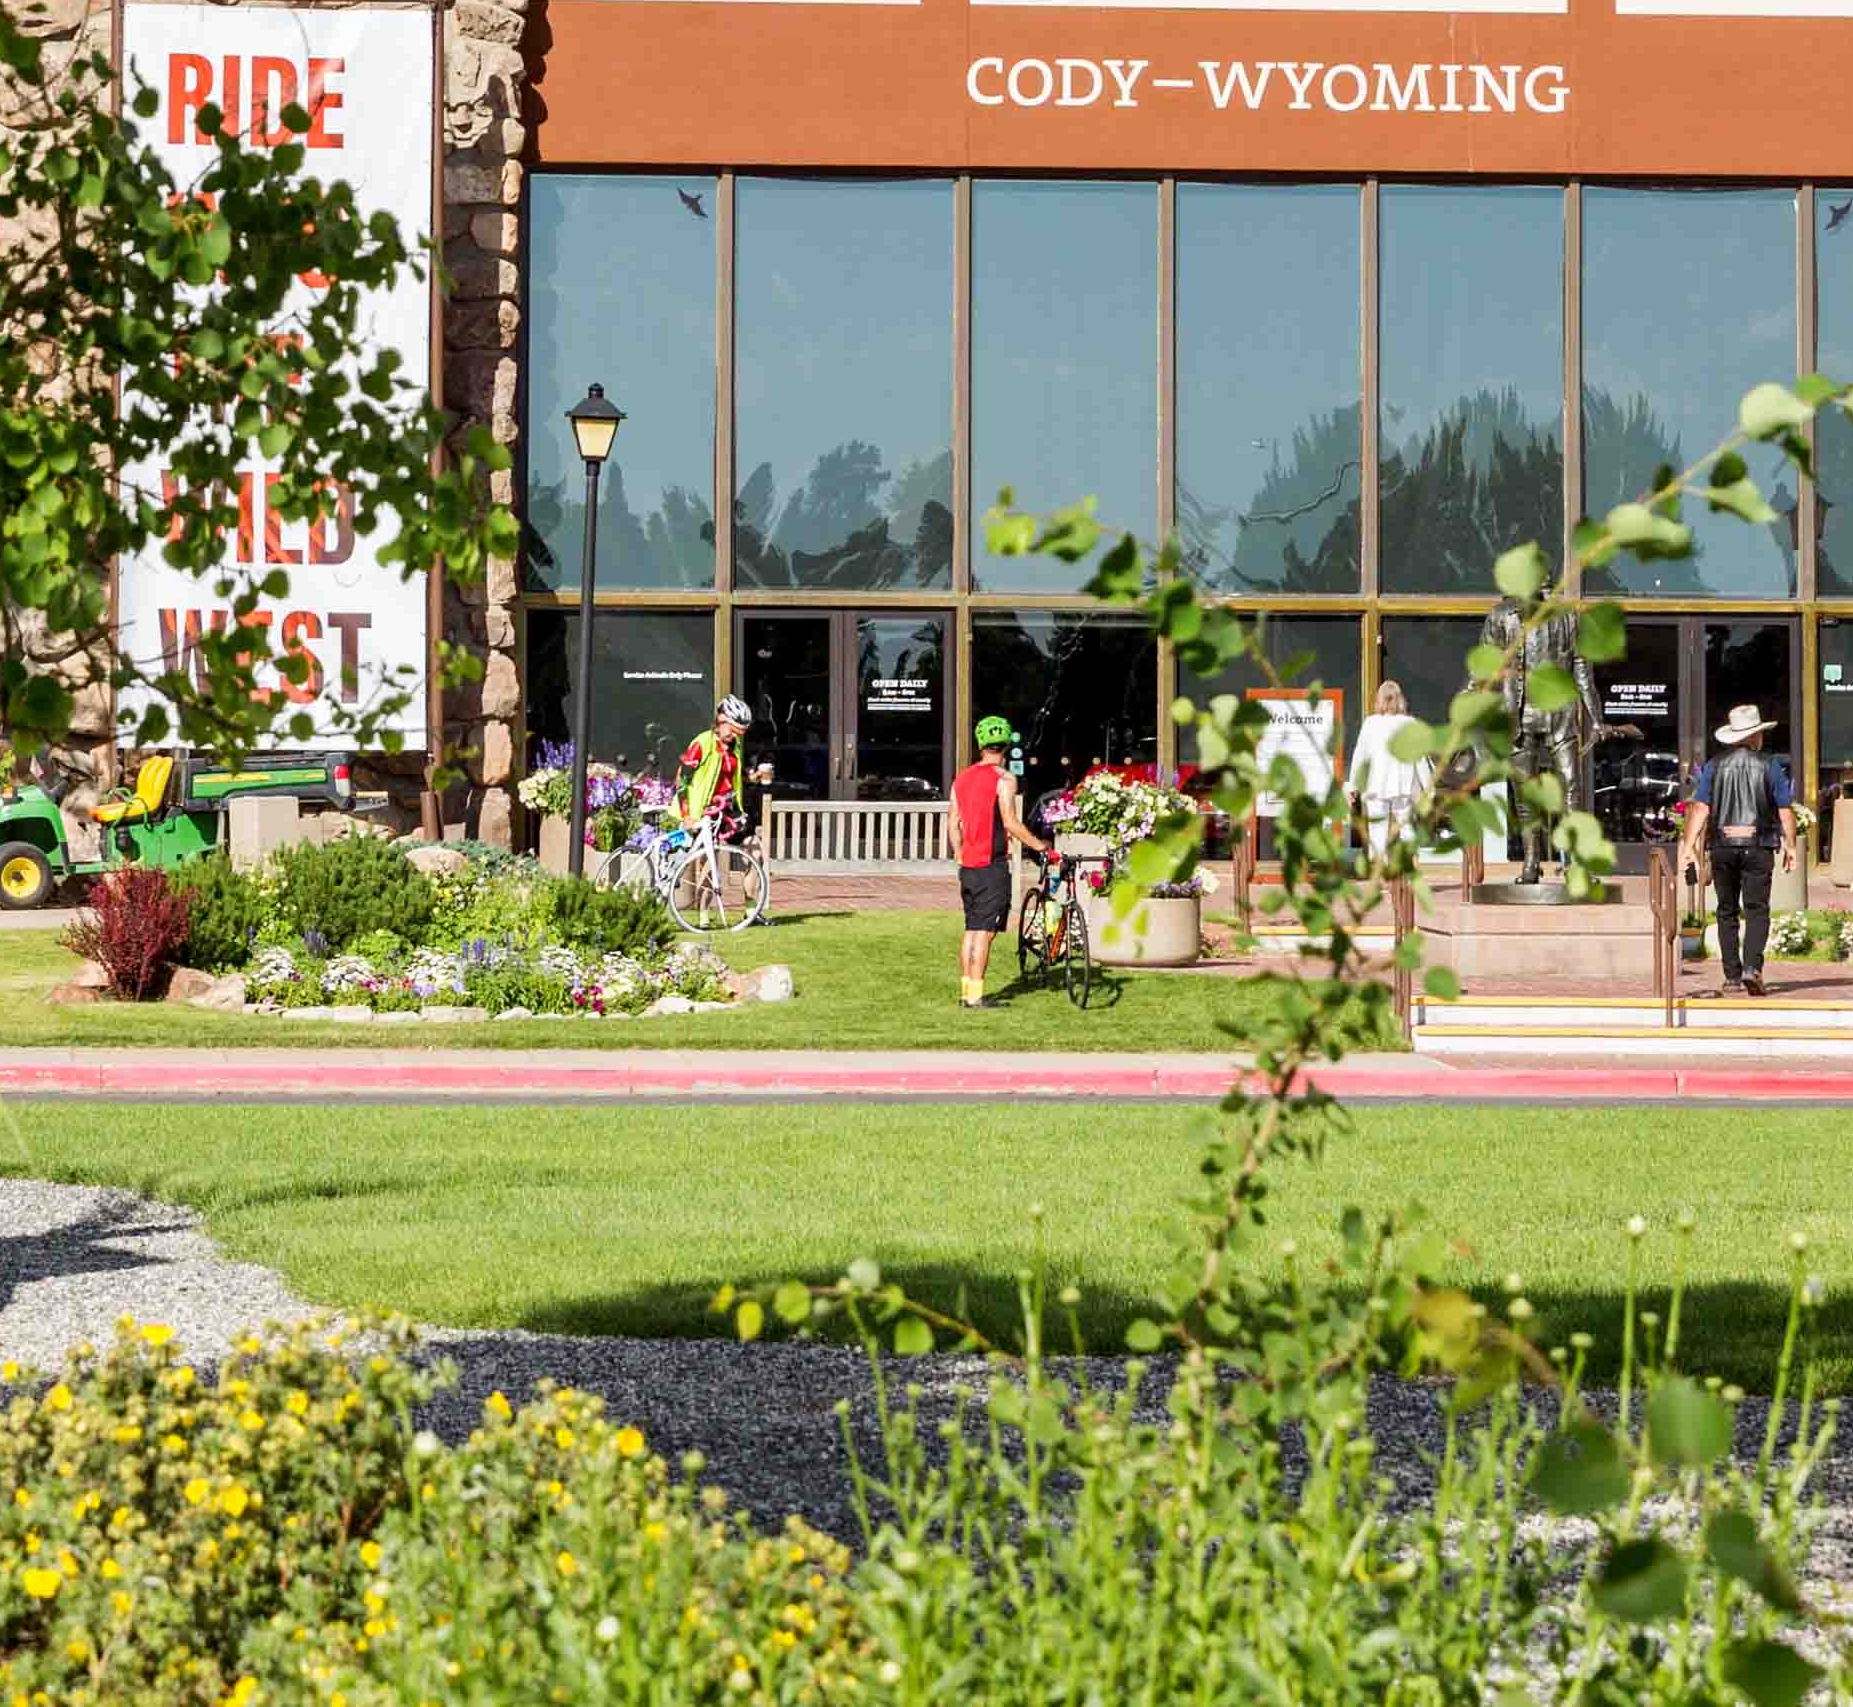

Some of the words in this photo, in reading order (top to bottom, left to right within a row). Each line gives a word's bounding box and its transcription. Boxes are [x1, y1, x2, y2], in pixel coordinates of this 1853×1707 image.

[167, 53, 345, 149] RIDE
[872, 679, 899, 688] OPEN
[900, 679, 928, 688] DAILY
[1610, 684, 1636, 693] OPEN
